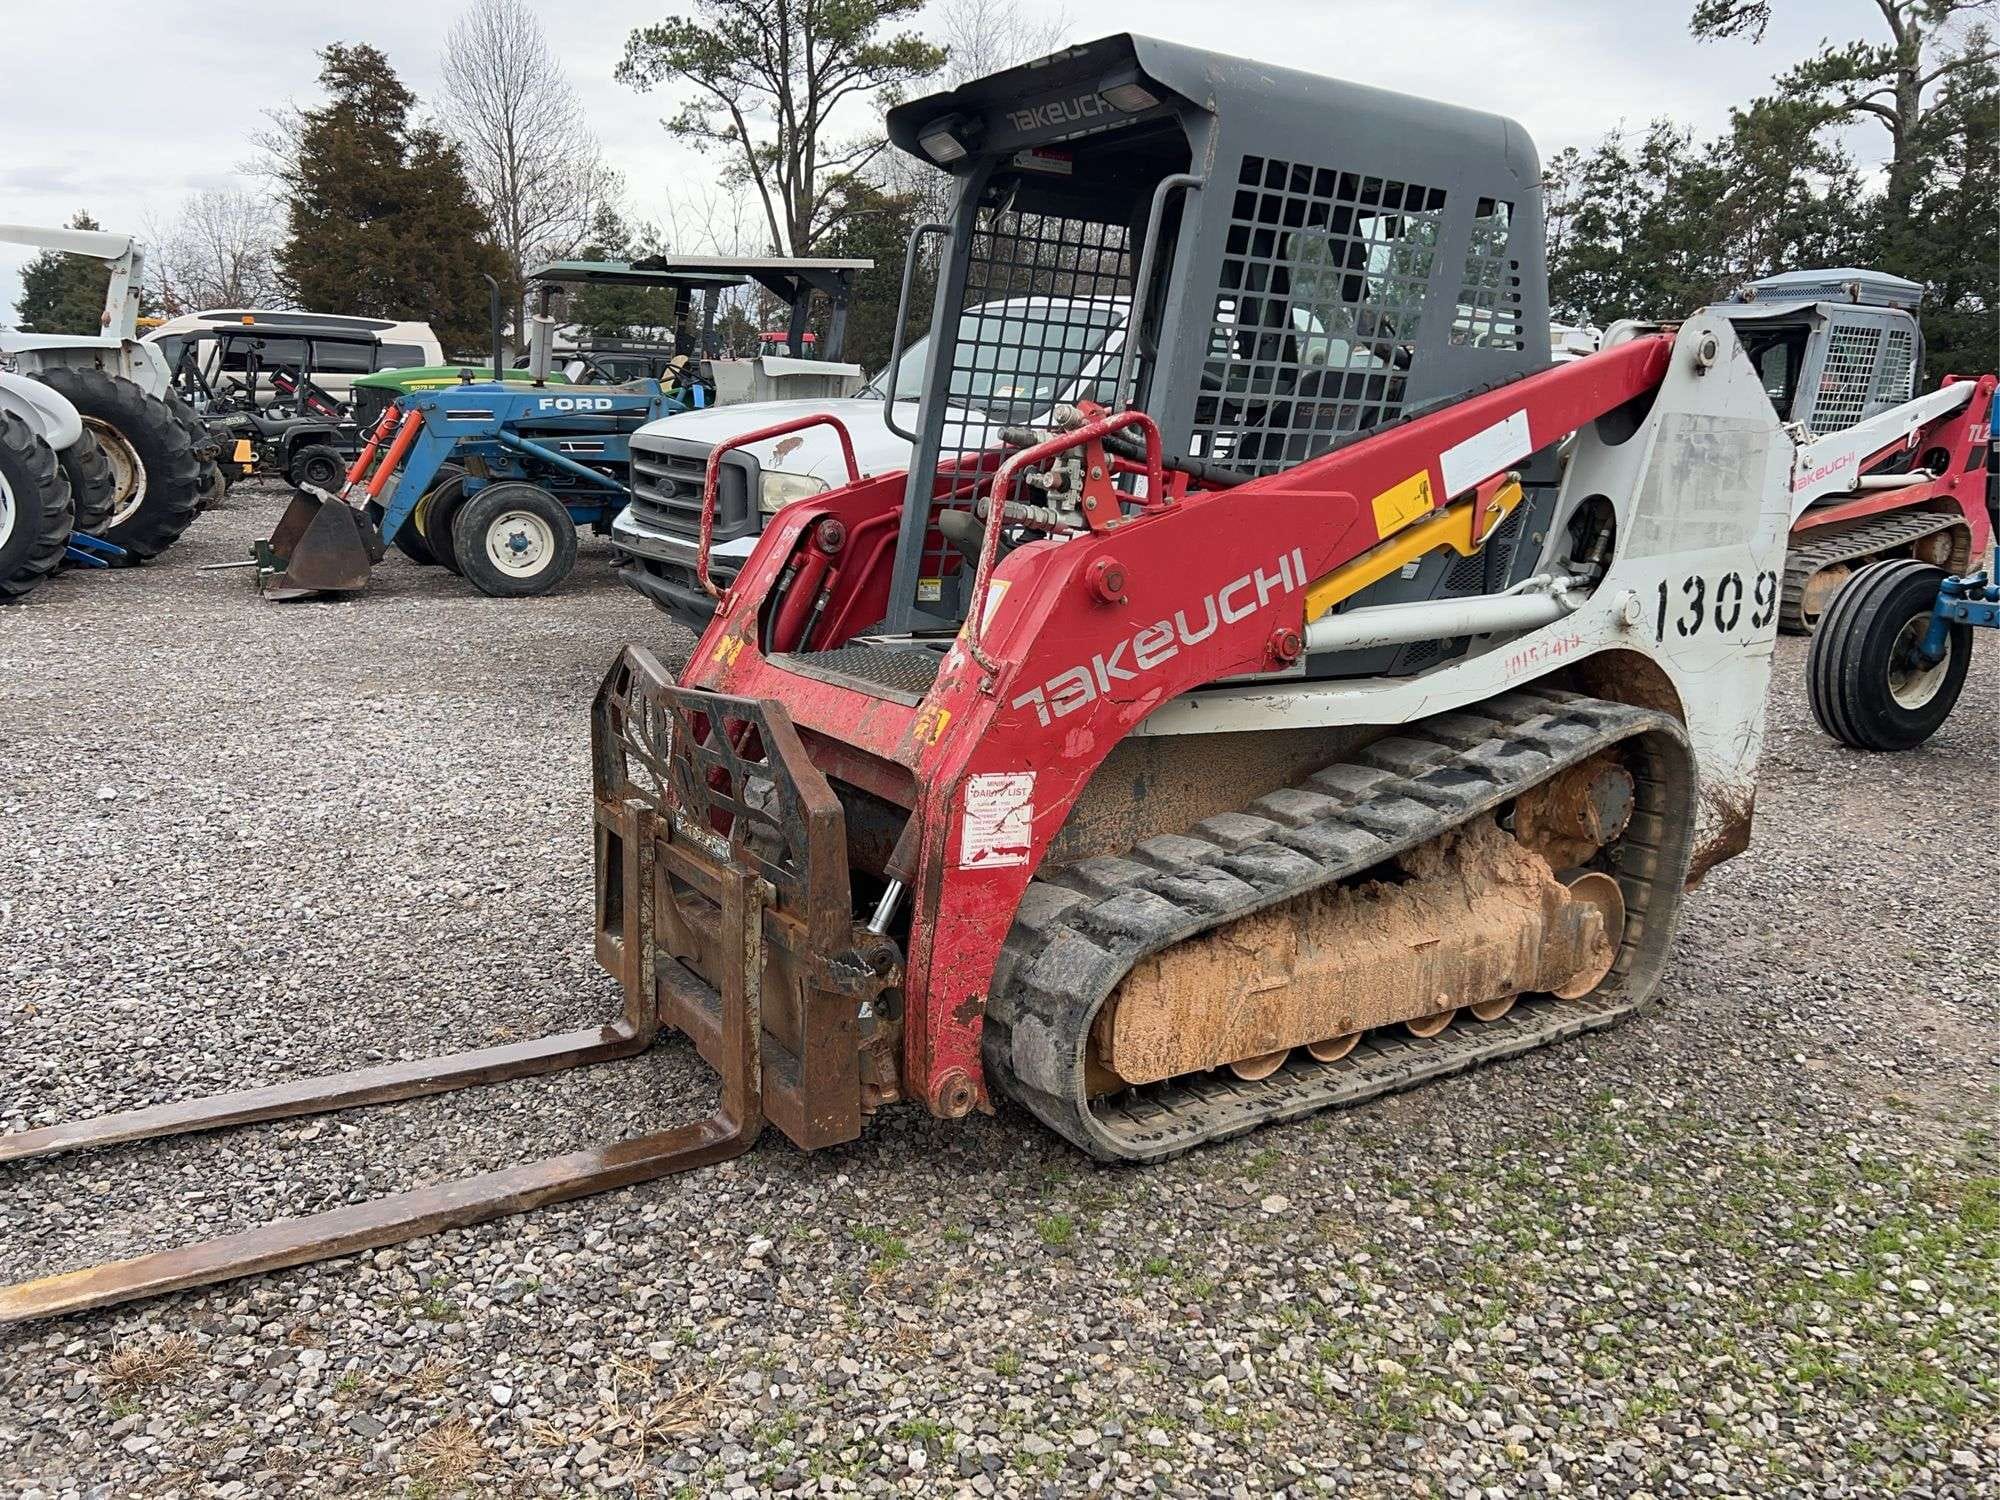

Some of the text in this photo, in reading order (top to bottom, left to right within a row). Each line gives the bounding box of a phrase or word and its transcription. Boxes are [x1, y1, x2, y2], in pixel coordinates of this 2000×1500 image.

[1006, 93, 1114, 132] TAKEUCH
[539, 398, 613, 410] FORD
[1968, 422, 1992, 443] TL2
[1655, 570, 1777, 643] 1309
[1012, 547, 1307, 727] TAKEUCHI
[1008, 787, 1026, 796] LIST
